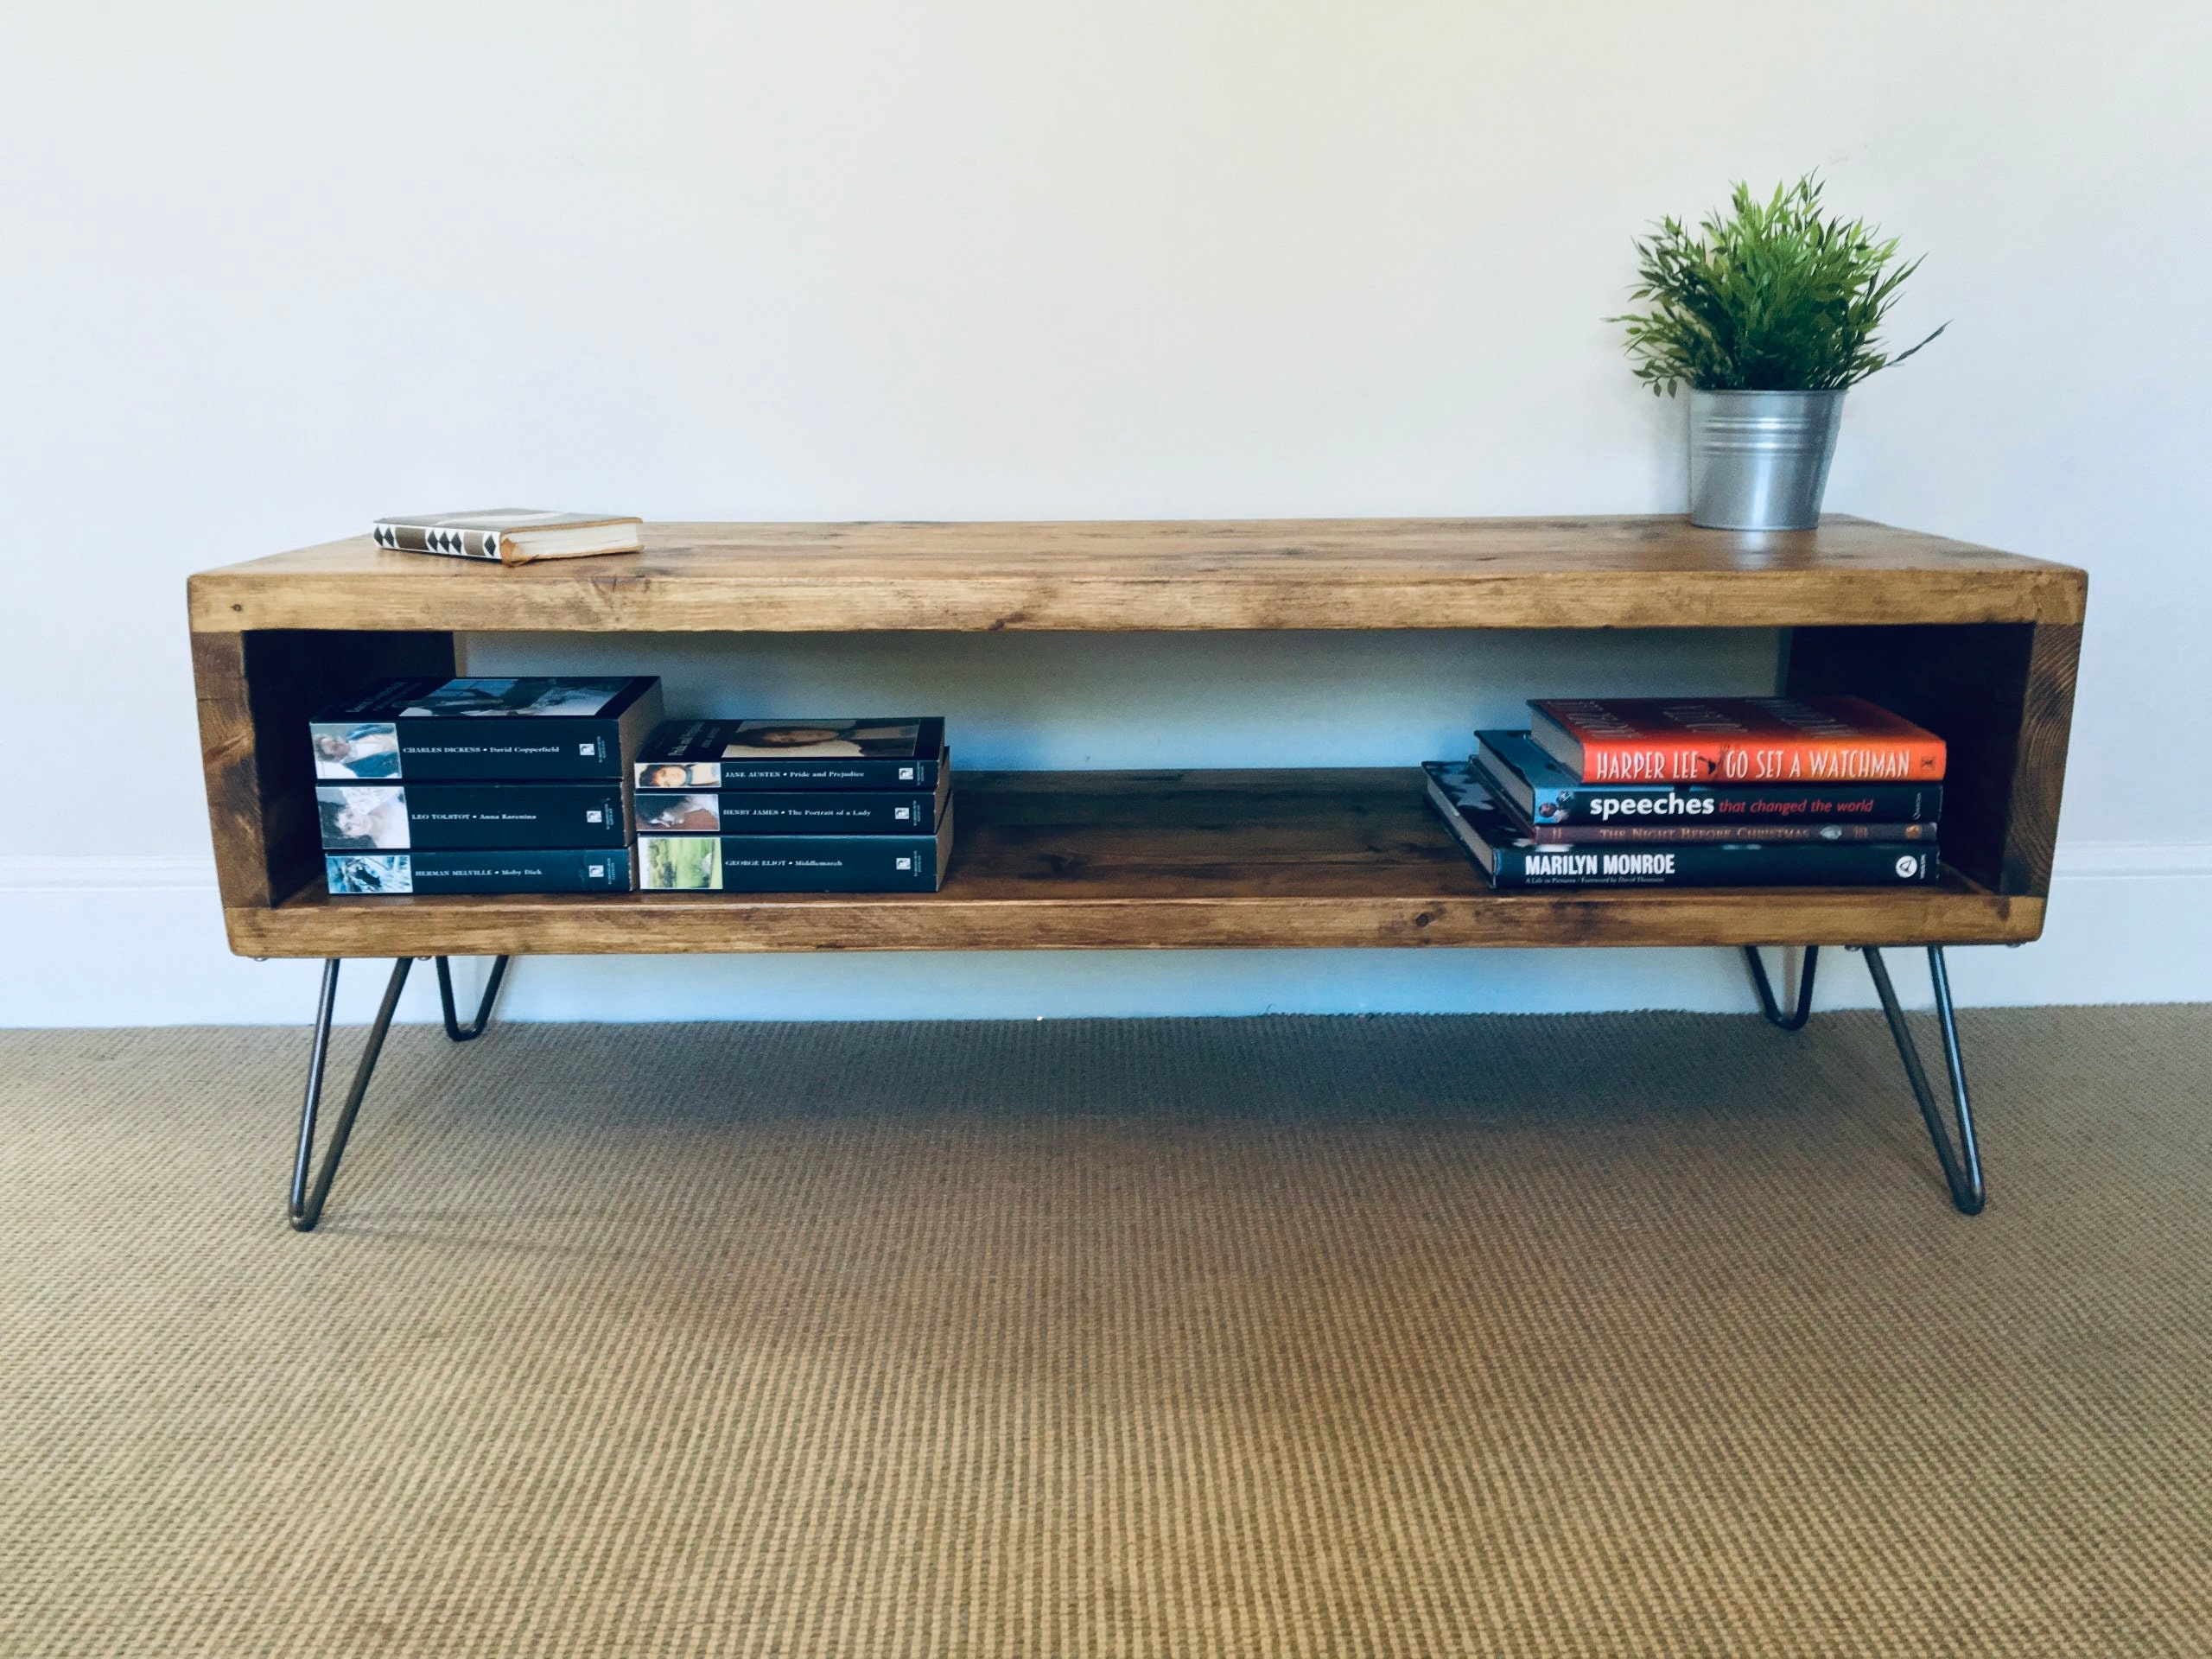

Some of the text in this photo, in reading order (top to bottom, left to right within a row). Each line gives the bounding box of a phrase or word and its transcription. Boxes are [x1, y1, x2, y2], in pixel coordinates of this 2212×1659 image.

[514, 746, 560, 754] Copperfield
[1597, 749, 1911, 779] HARPER LEE GO SET A WATCHMAN
[852, 809, 872, 817] Lady
[1590, 791, 1874, 821] speeches that changed the world
[1525, 854, 1676, 875] MARILYN MONROE
